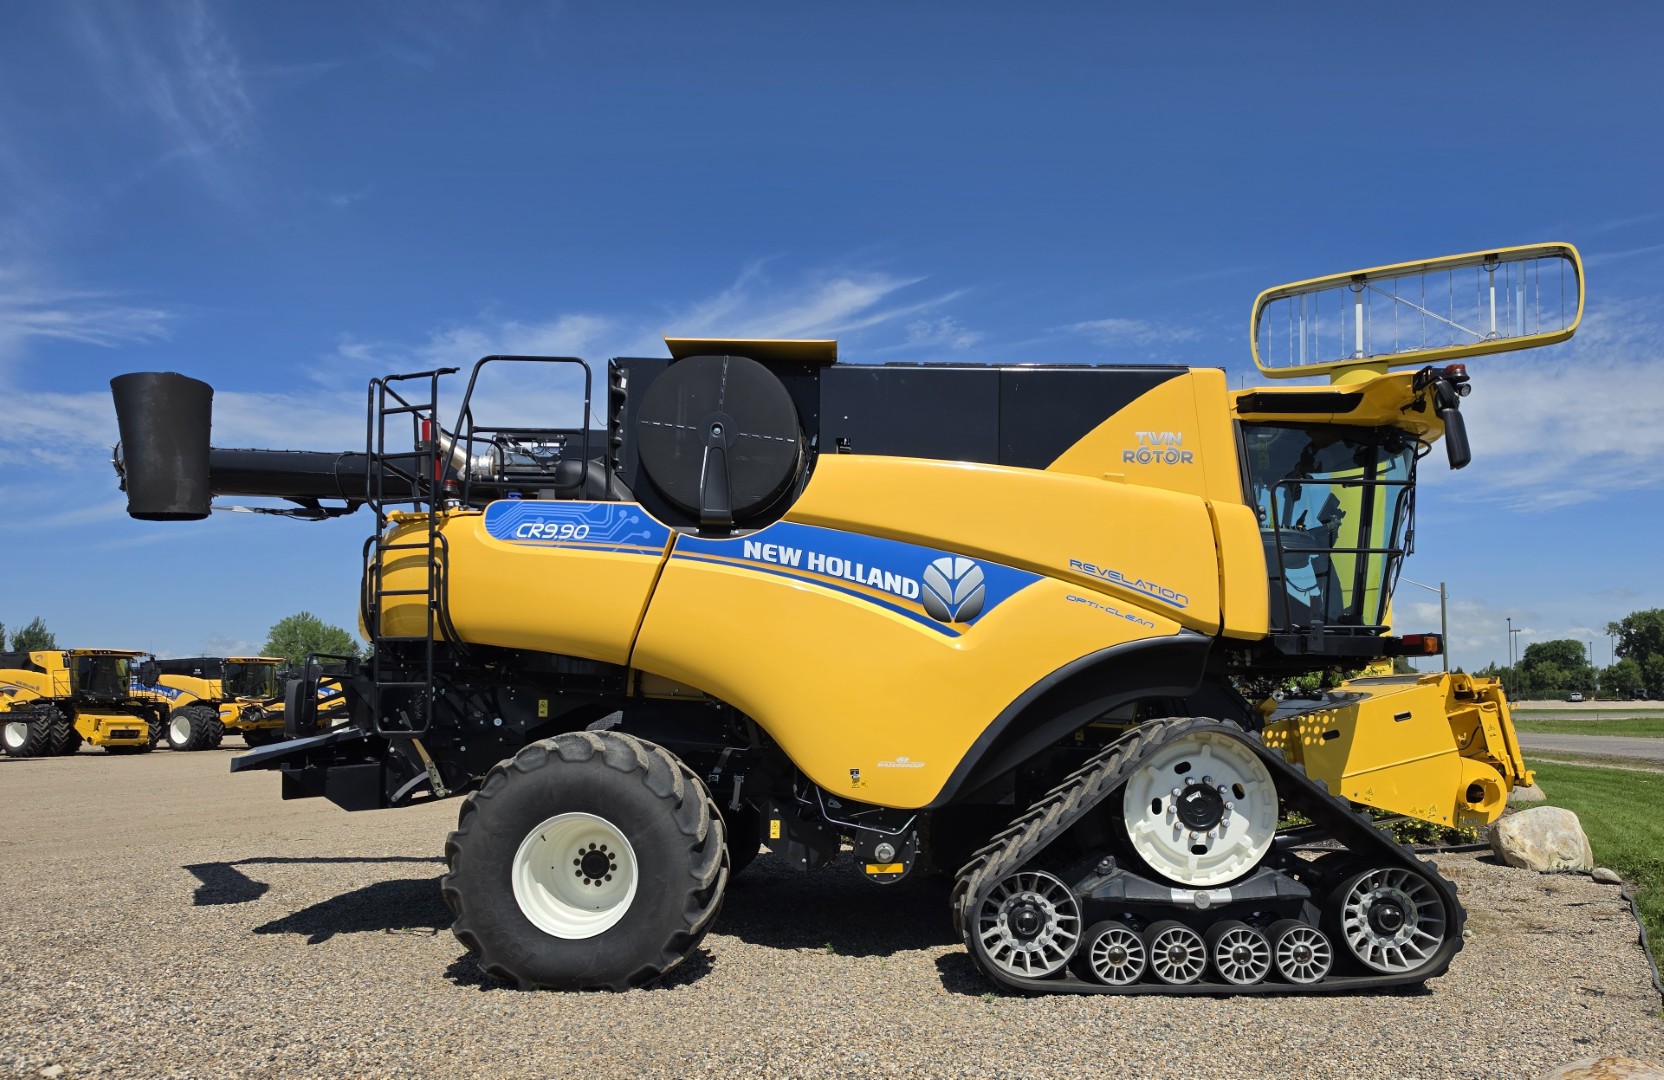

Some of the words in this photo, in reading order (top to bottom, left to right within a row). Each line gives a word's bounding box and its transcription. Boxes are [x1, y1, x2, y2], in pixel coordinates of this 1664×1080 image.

[1135, 431, 1183, 446] TWIN
[1123, 446, 1194, 464] ROTOR
[516, 522, 590, 541] CR9.90
[743, 540, 802, 566] NEW
[807, 550, 919, 600] HOLLAND
[1069, 559, 1189, 604] REVELATION
